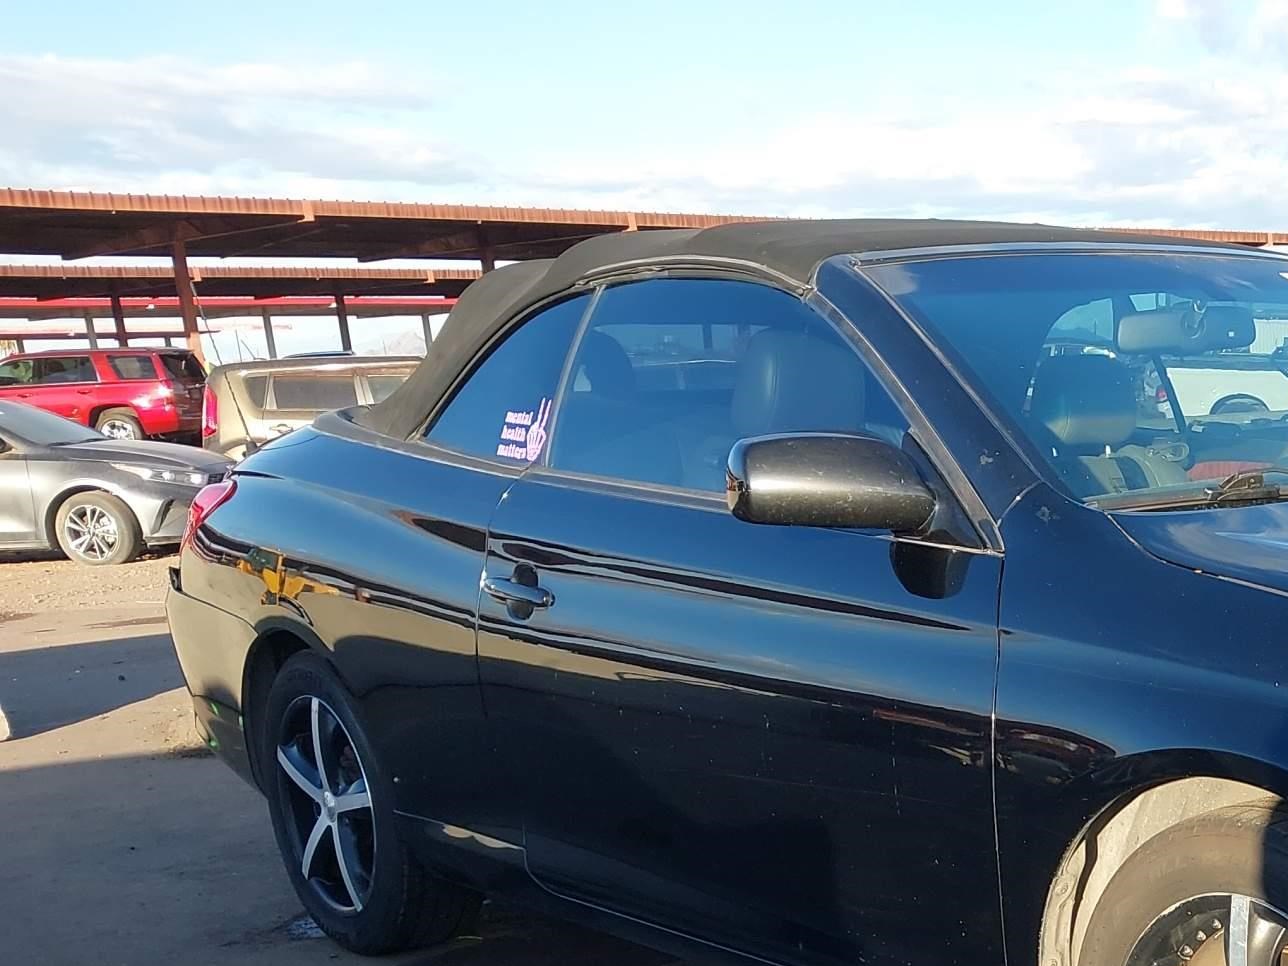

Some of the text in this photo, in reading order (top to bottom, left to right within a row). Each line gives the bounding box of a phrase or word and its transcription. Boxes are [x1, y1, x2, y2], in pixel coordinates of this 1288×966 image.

[505, 411, 534, 426] mental
[501, 425, 526, 442] health
[496, 443, 527, 459] matters
